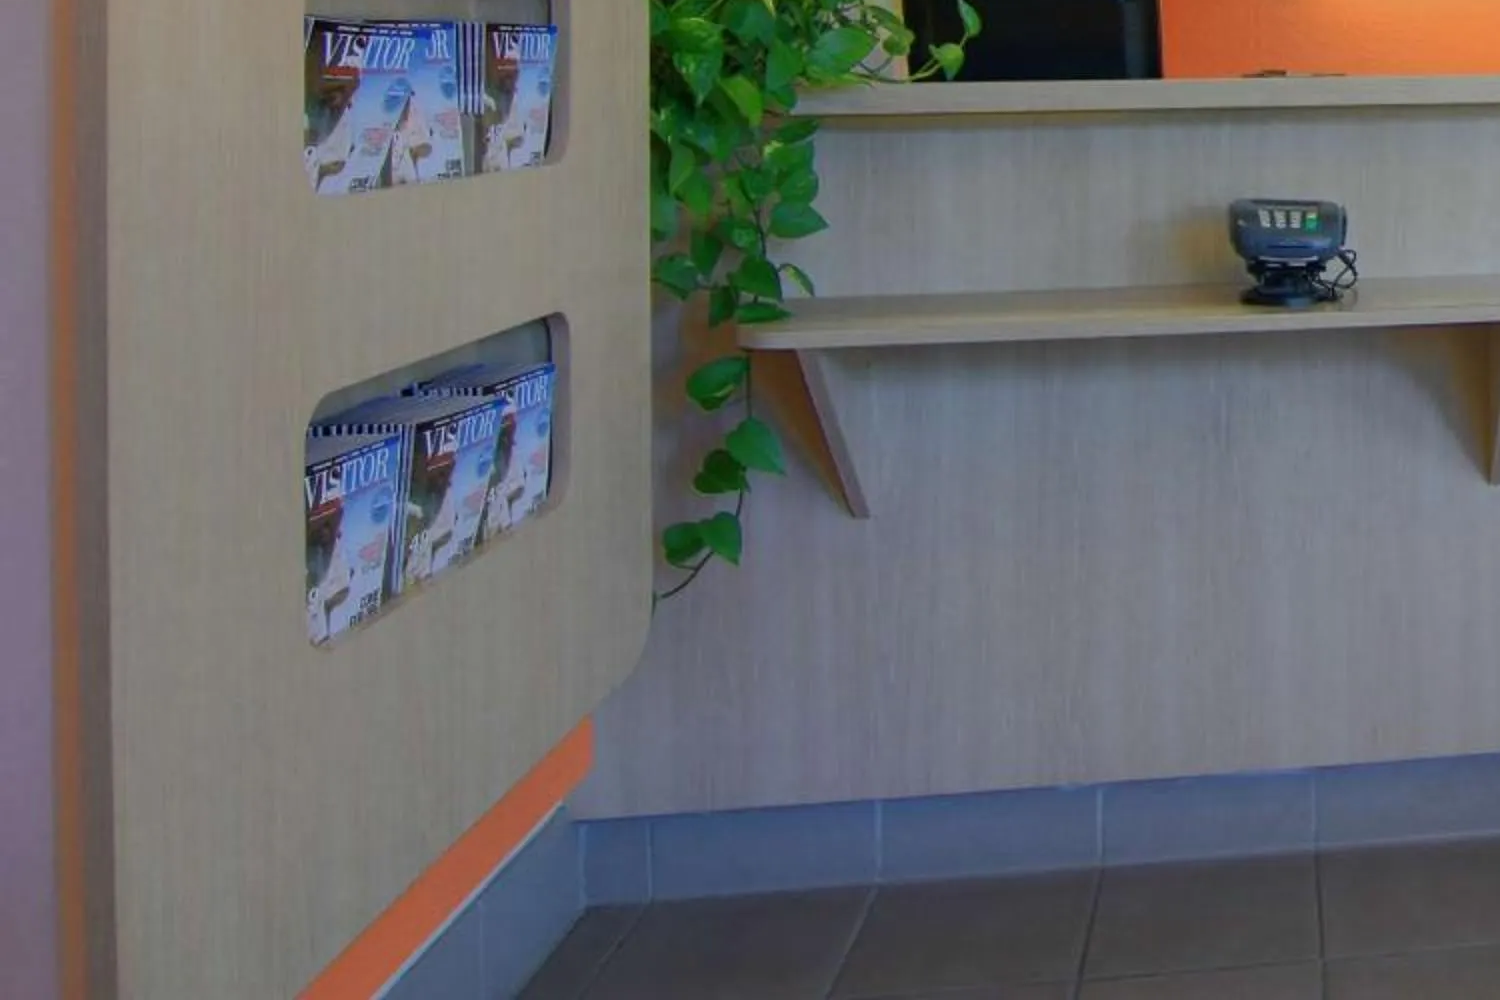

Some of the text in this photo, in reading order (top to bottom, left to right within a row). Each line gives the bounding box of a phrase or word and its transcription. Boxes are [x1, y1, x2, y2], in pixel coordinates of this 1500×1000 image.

[323, 30, 416, 70] VISITOR
[493, 31, 550, 60] VISITOR
[423, 409, 497, 460] VISITOR
[304, 447, 389, 511] VISITOR
